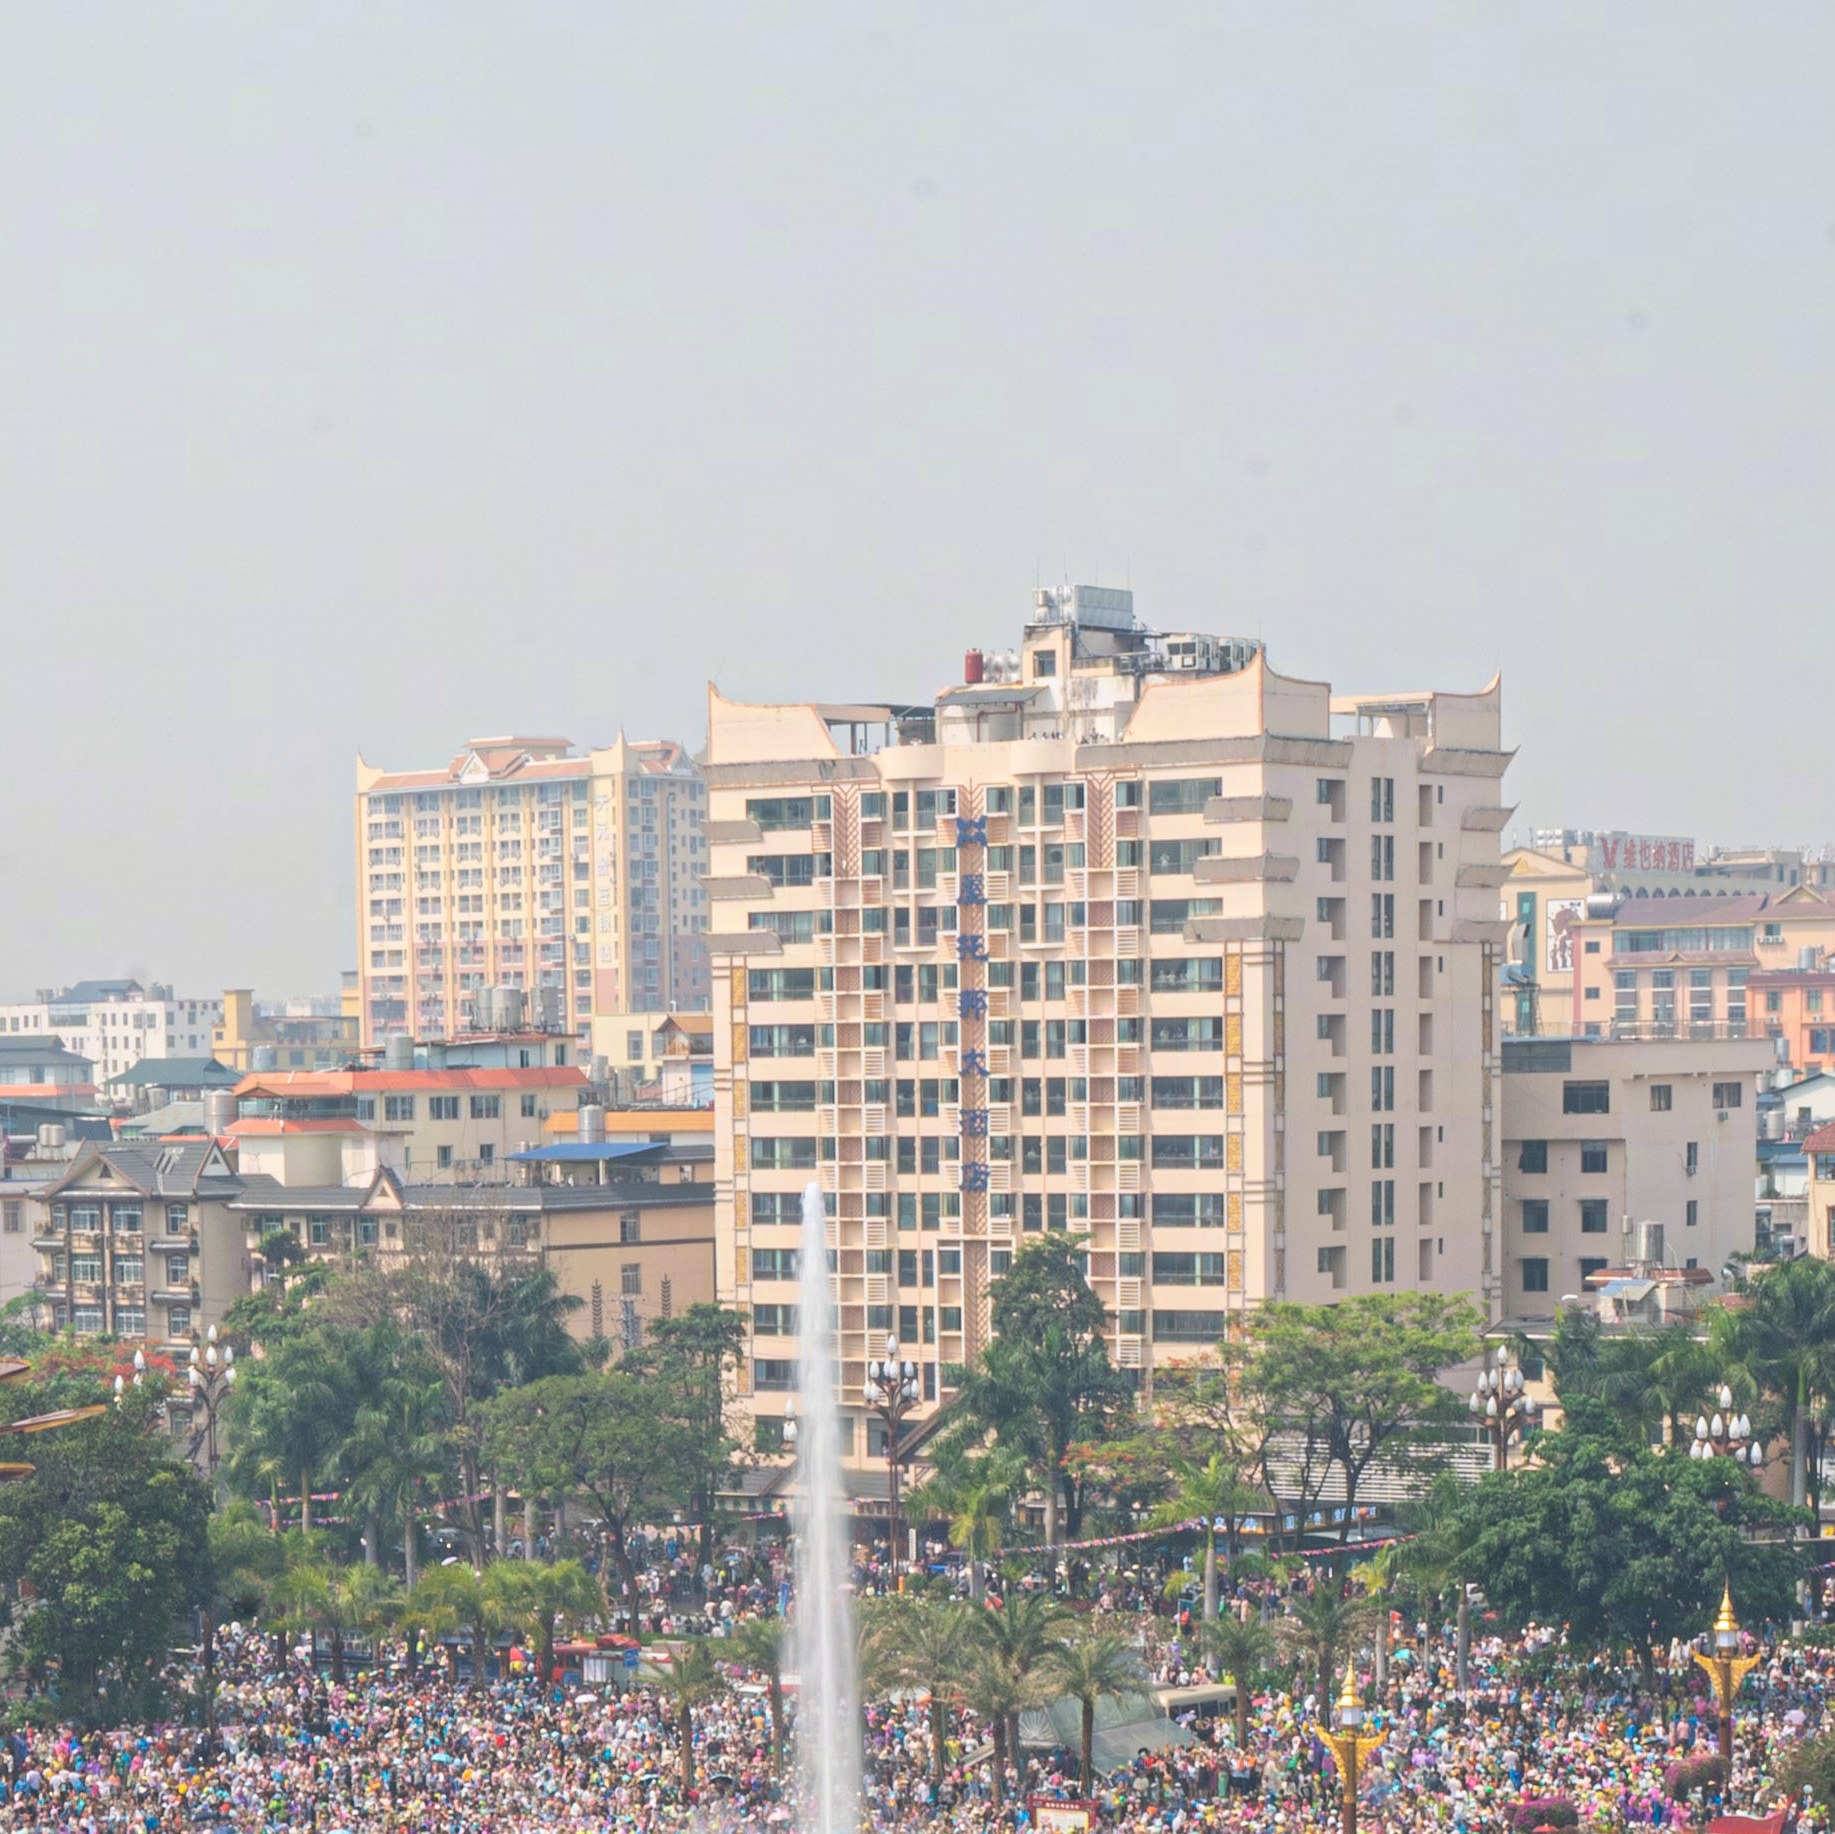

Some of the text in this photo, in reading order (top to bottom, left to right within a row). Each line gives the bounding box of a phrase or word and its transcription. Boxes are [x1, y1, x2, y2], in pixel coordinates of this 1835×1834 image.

[1623, 839, 1694, 873] 维也纳酒店
